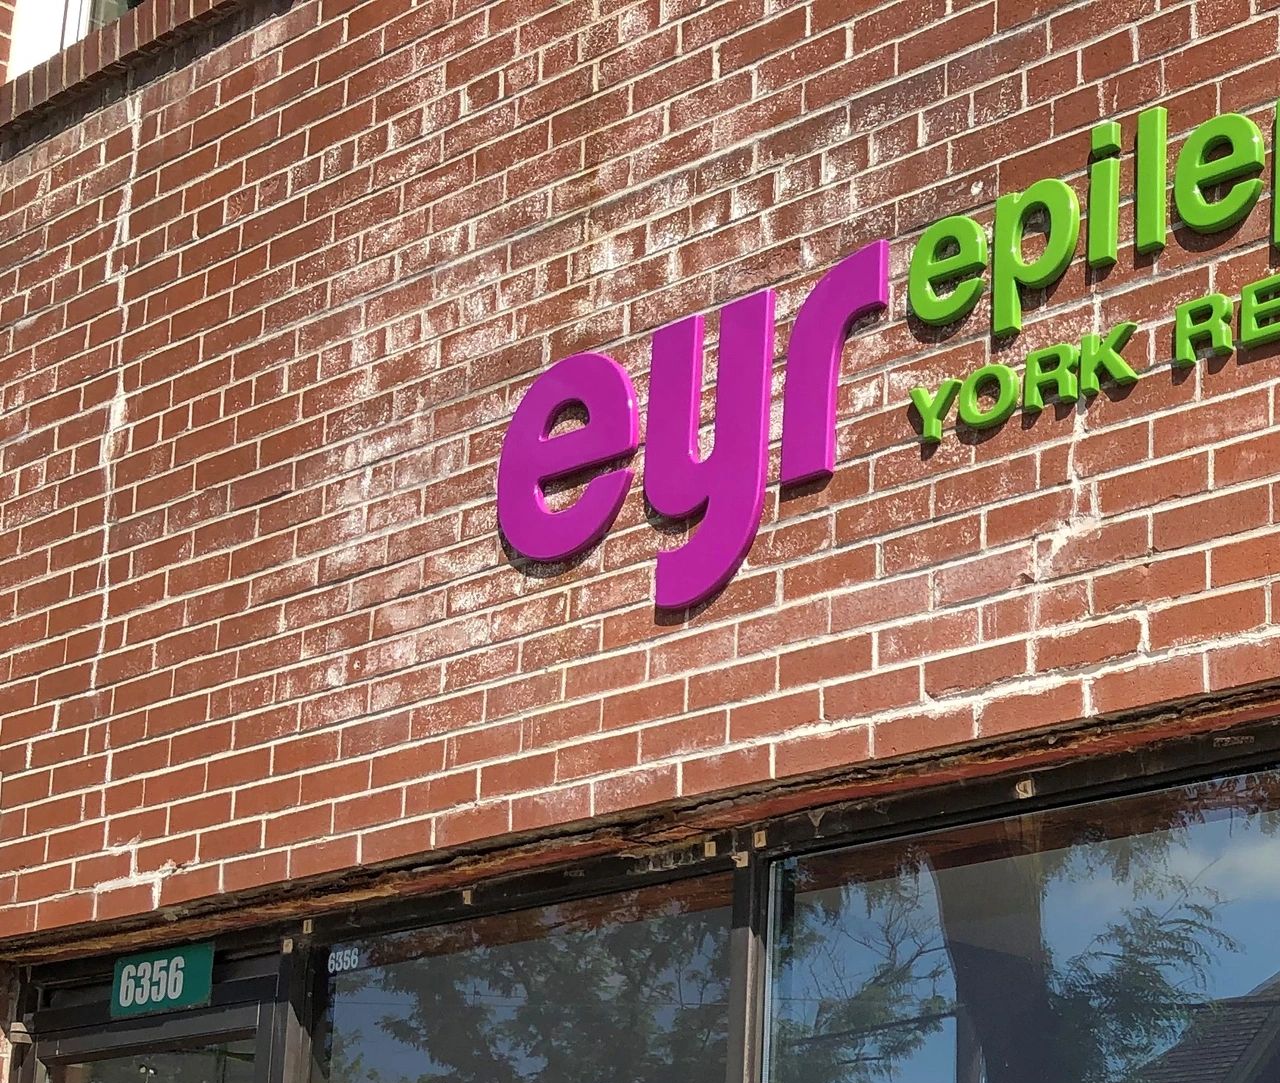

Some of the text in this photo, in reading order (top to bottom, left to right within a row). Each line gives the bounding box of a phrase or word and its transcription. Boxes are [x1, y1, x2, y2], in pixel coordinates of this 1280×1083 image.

[496, 238, 889, 608] eyr
[908, 320, 1140, 443] YORK
[118, 956, 186, 1008] 6356
[328, 948, 360, 973] 6356
